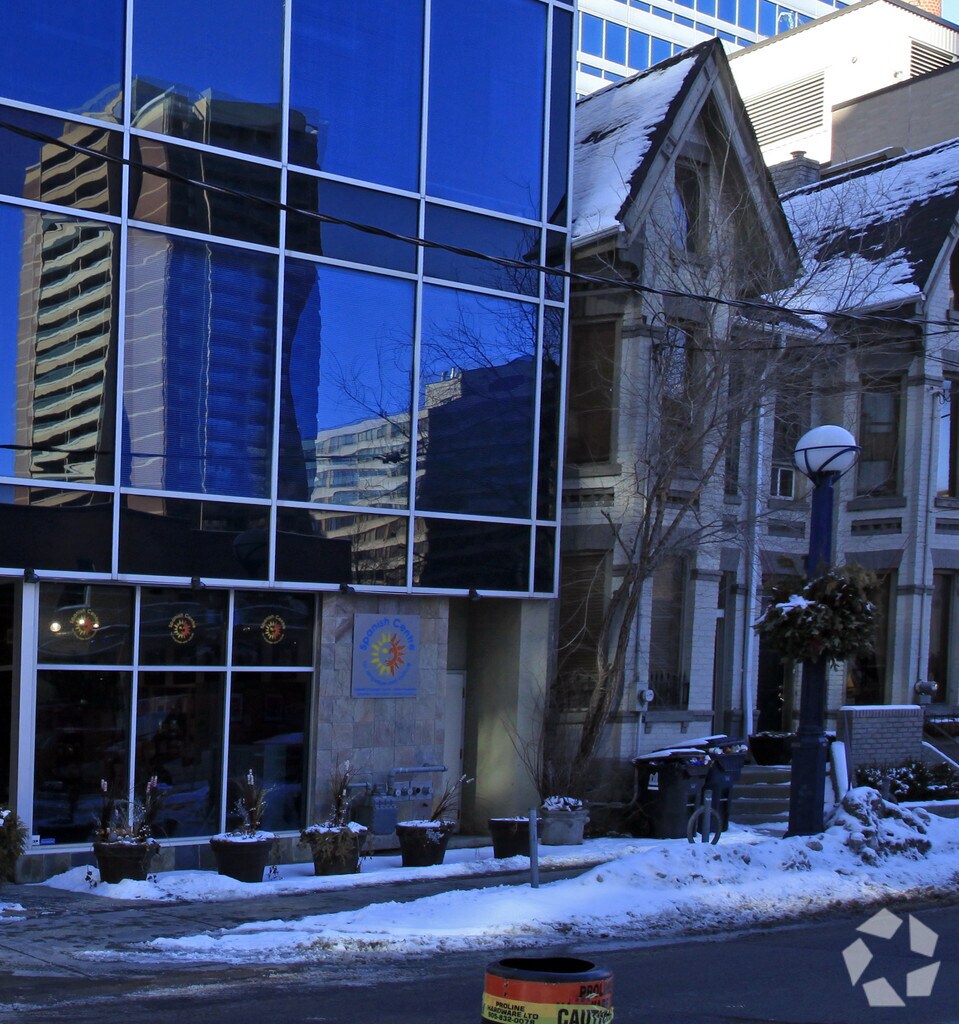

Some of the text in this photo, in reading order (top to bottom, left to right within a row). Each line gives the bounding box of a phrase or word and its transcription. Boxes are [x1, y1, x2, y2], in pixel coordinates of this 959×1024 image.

[359, 617, 390, 651] Spanish
[487, 1005, 522, 1018] HARDWARE
[495, 1001, 526, 1012] PROLINE
